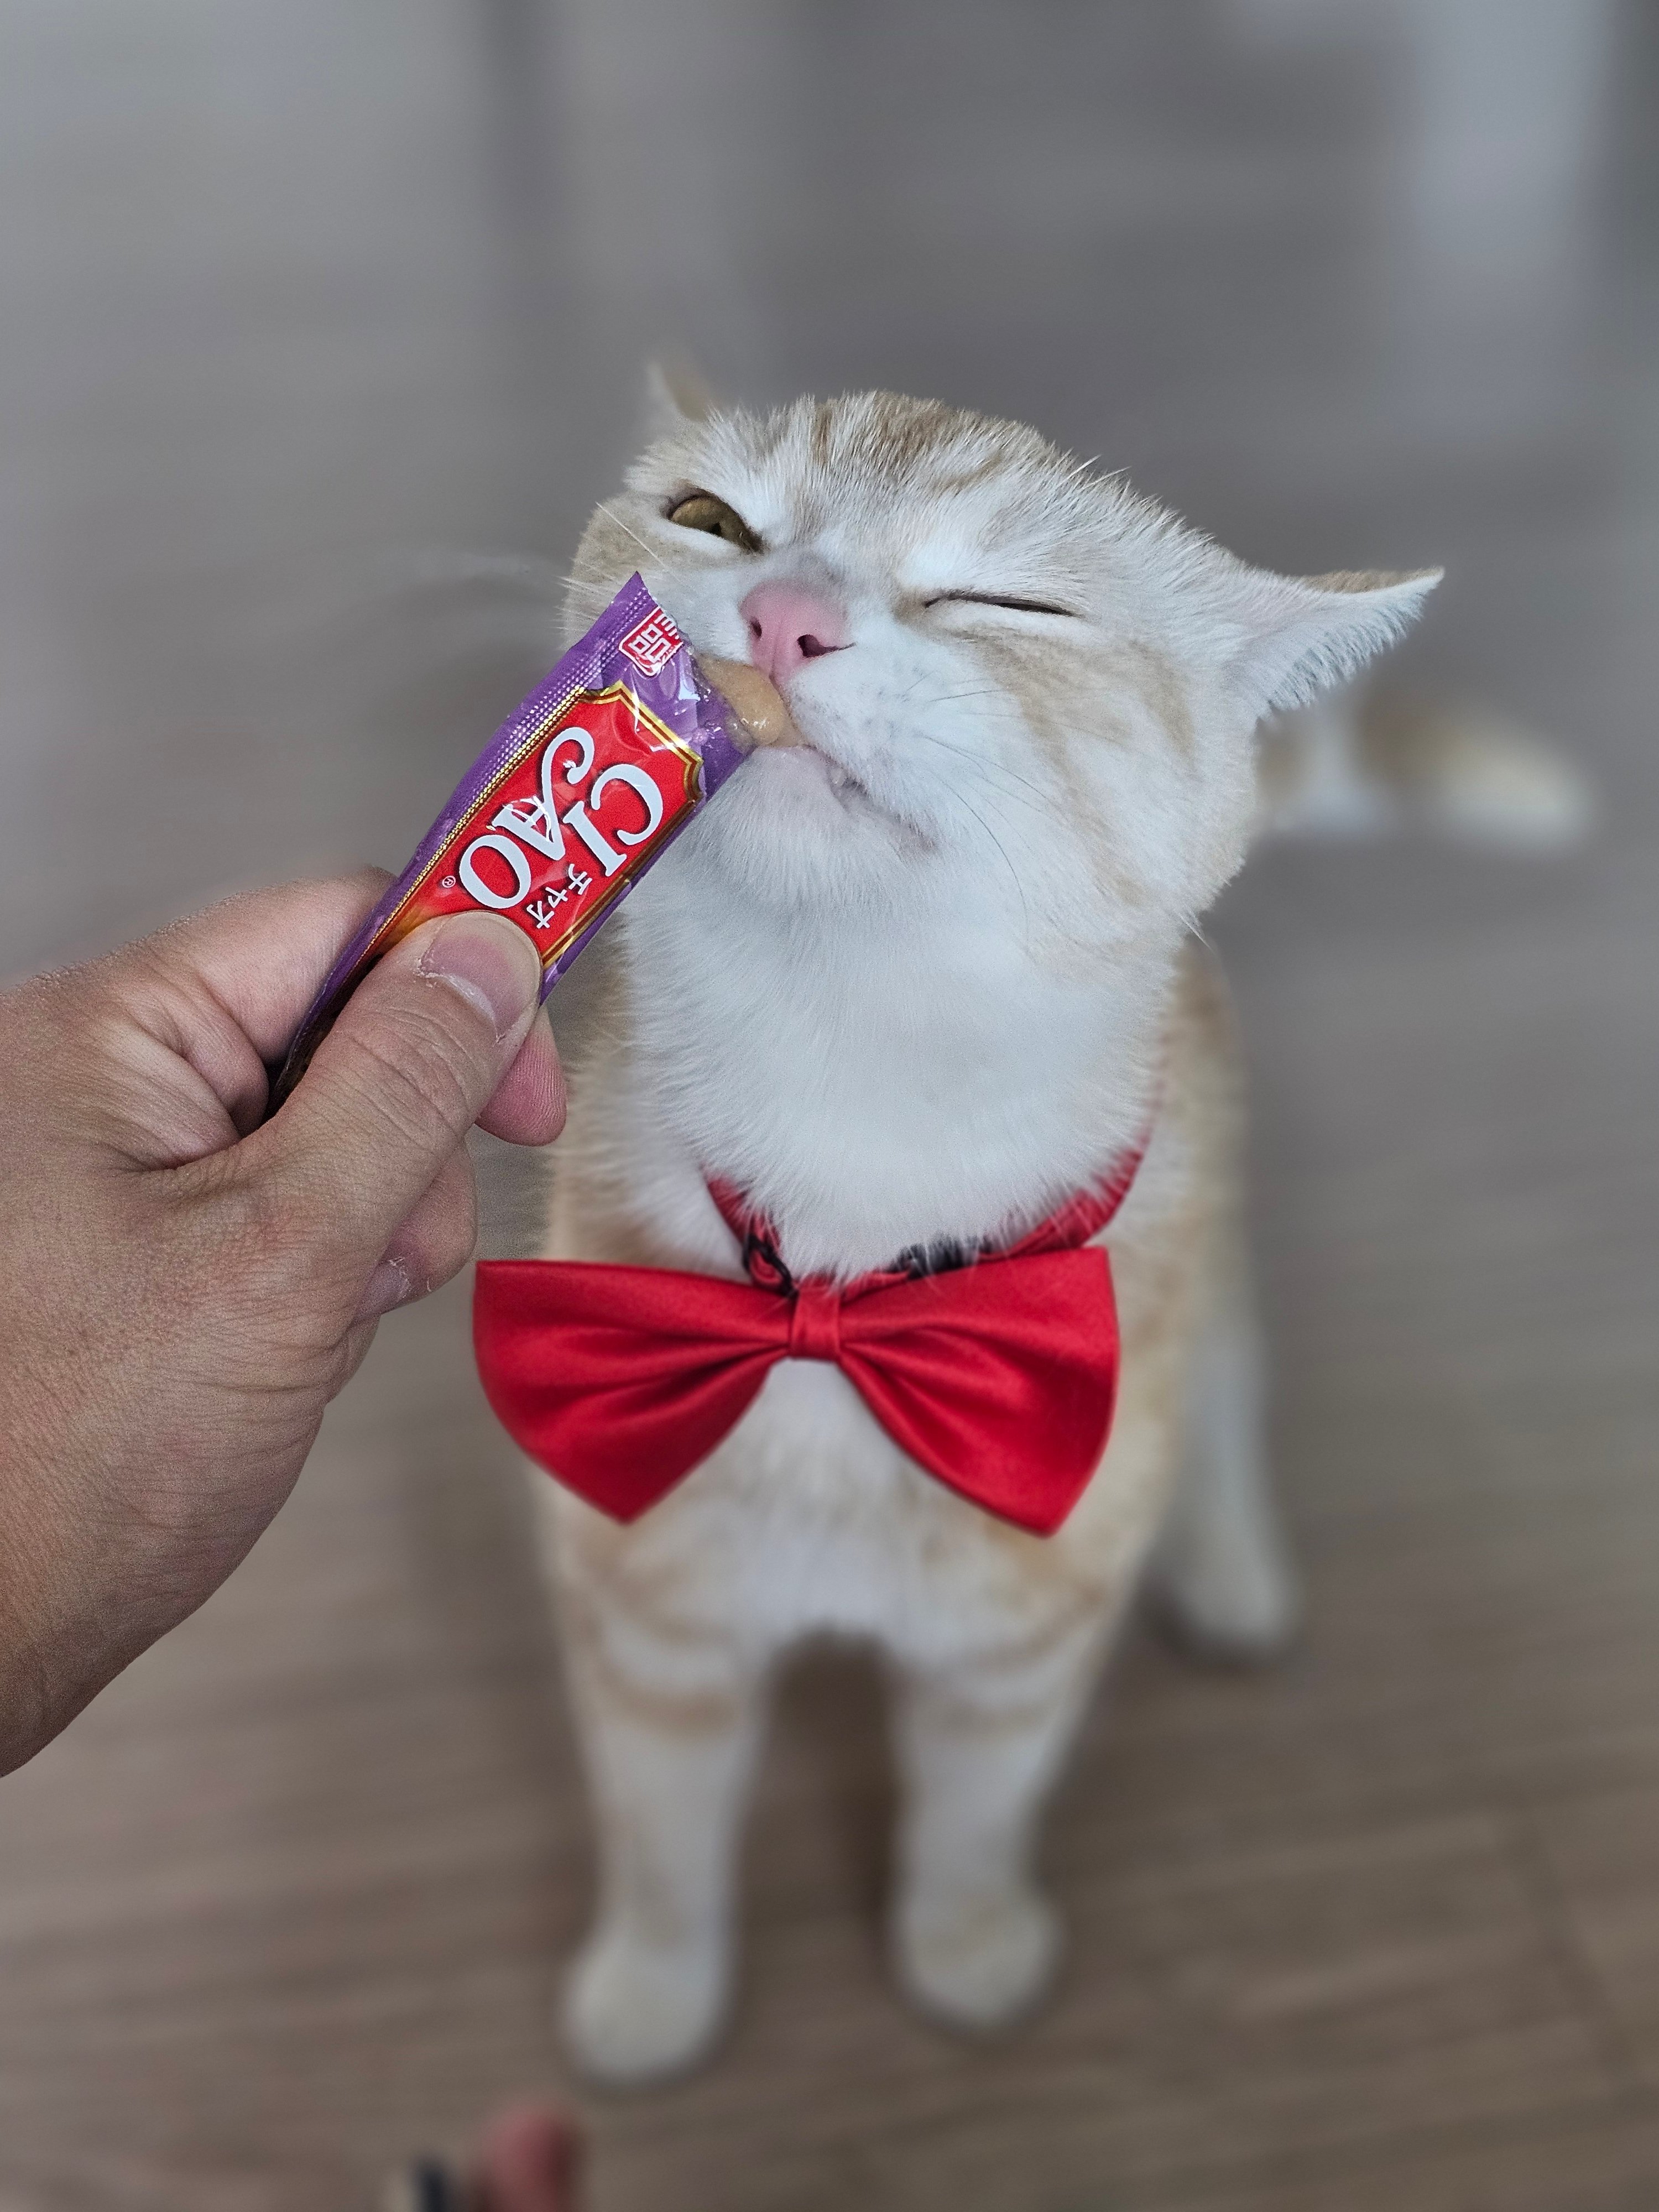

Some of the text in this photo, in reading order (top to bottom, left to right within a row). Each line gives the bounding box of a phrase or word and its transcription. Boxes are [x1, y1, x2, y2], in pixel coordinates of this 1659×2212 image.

[459, 727, 663, 910] CIAO
[526, 863, 592, 928] チャオ
